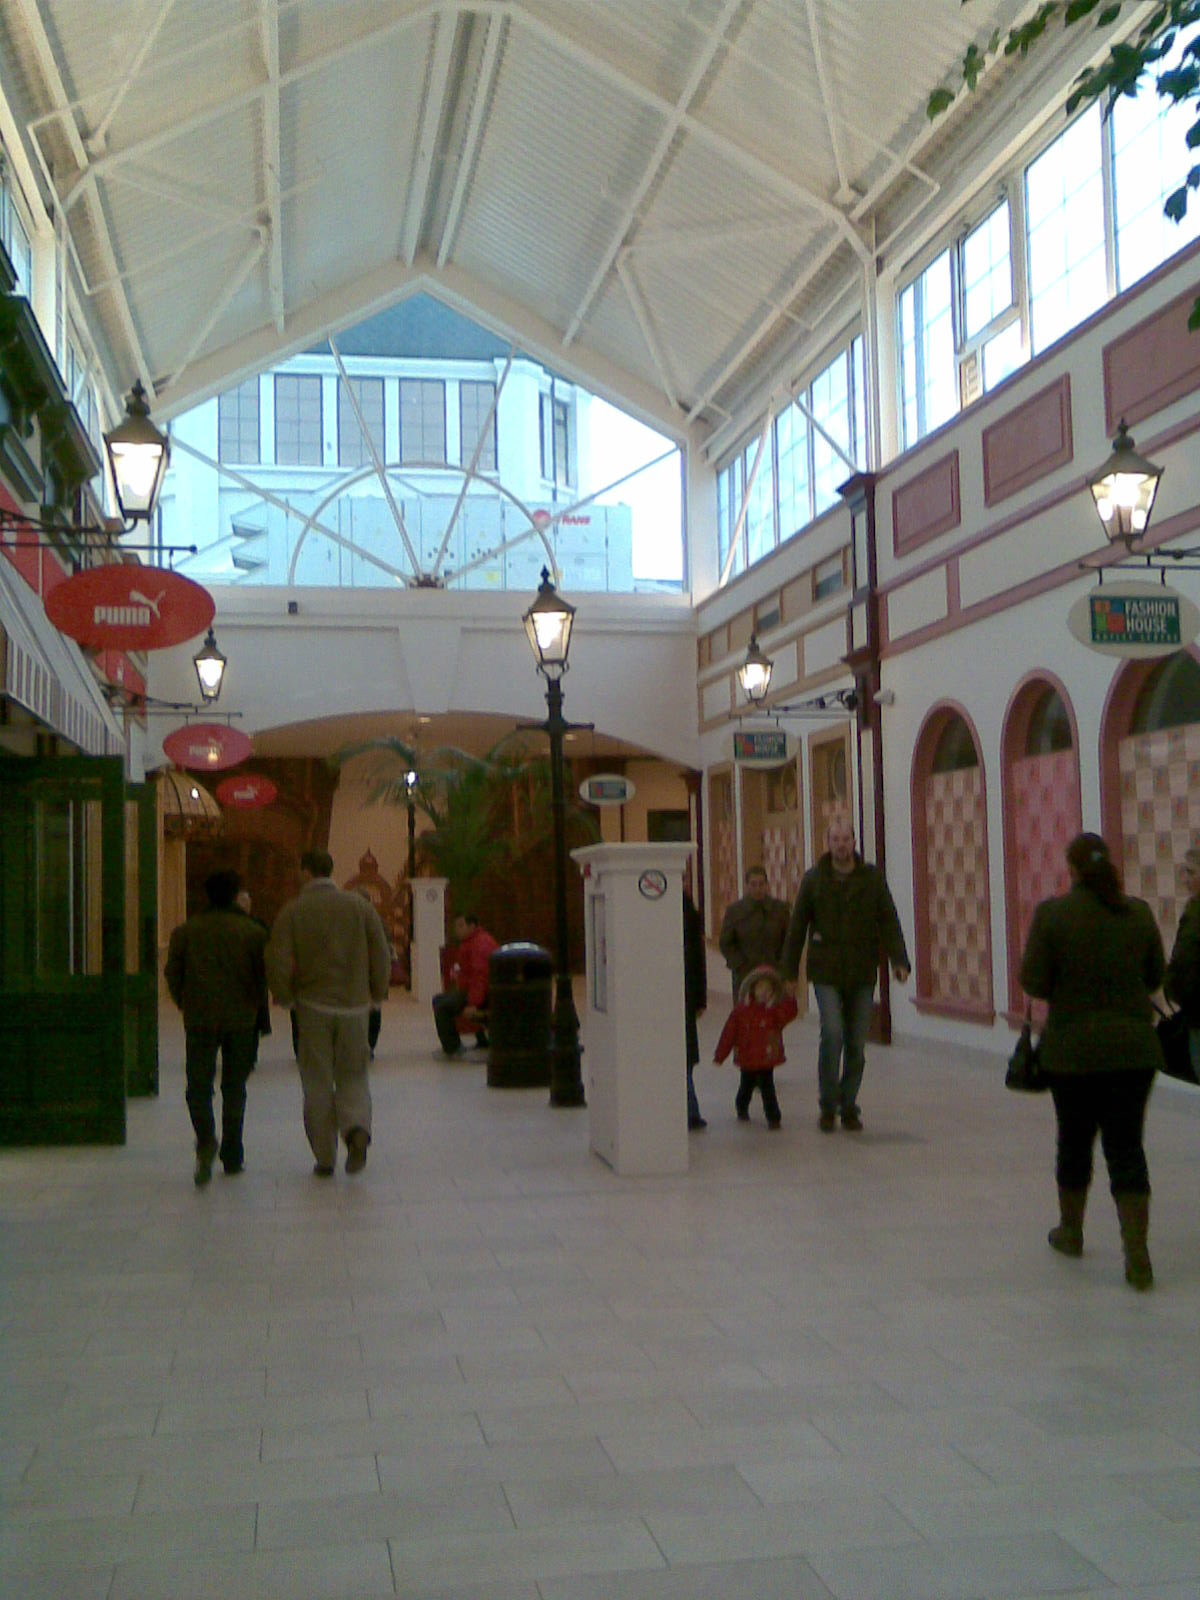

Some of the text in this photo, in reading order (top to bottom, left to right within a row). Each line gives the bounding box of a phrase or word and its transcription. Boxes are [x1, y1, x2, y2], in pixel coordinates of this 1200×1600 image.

[94, 605, 150, 625] PUMA
[1125, 600, 1176, 616] FASHION
[1126, 616, 1167, 633] HOUSE
